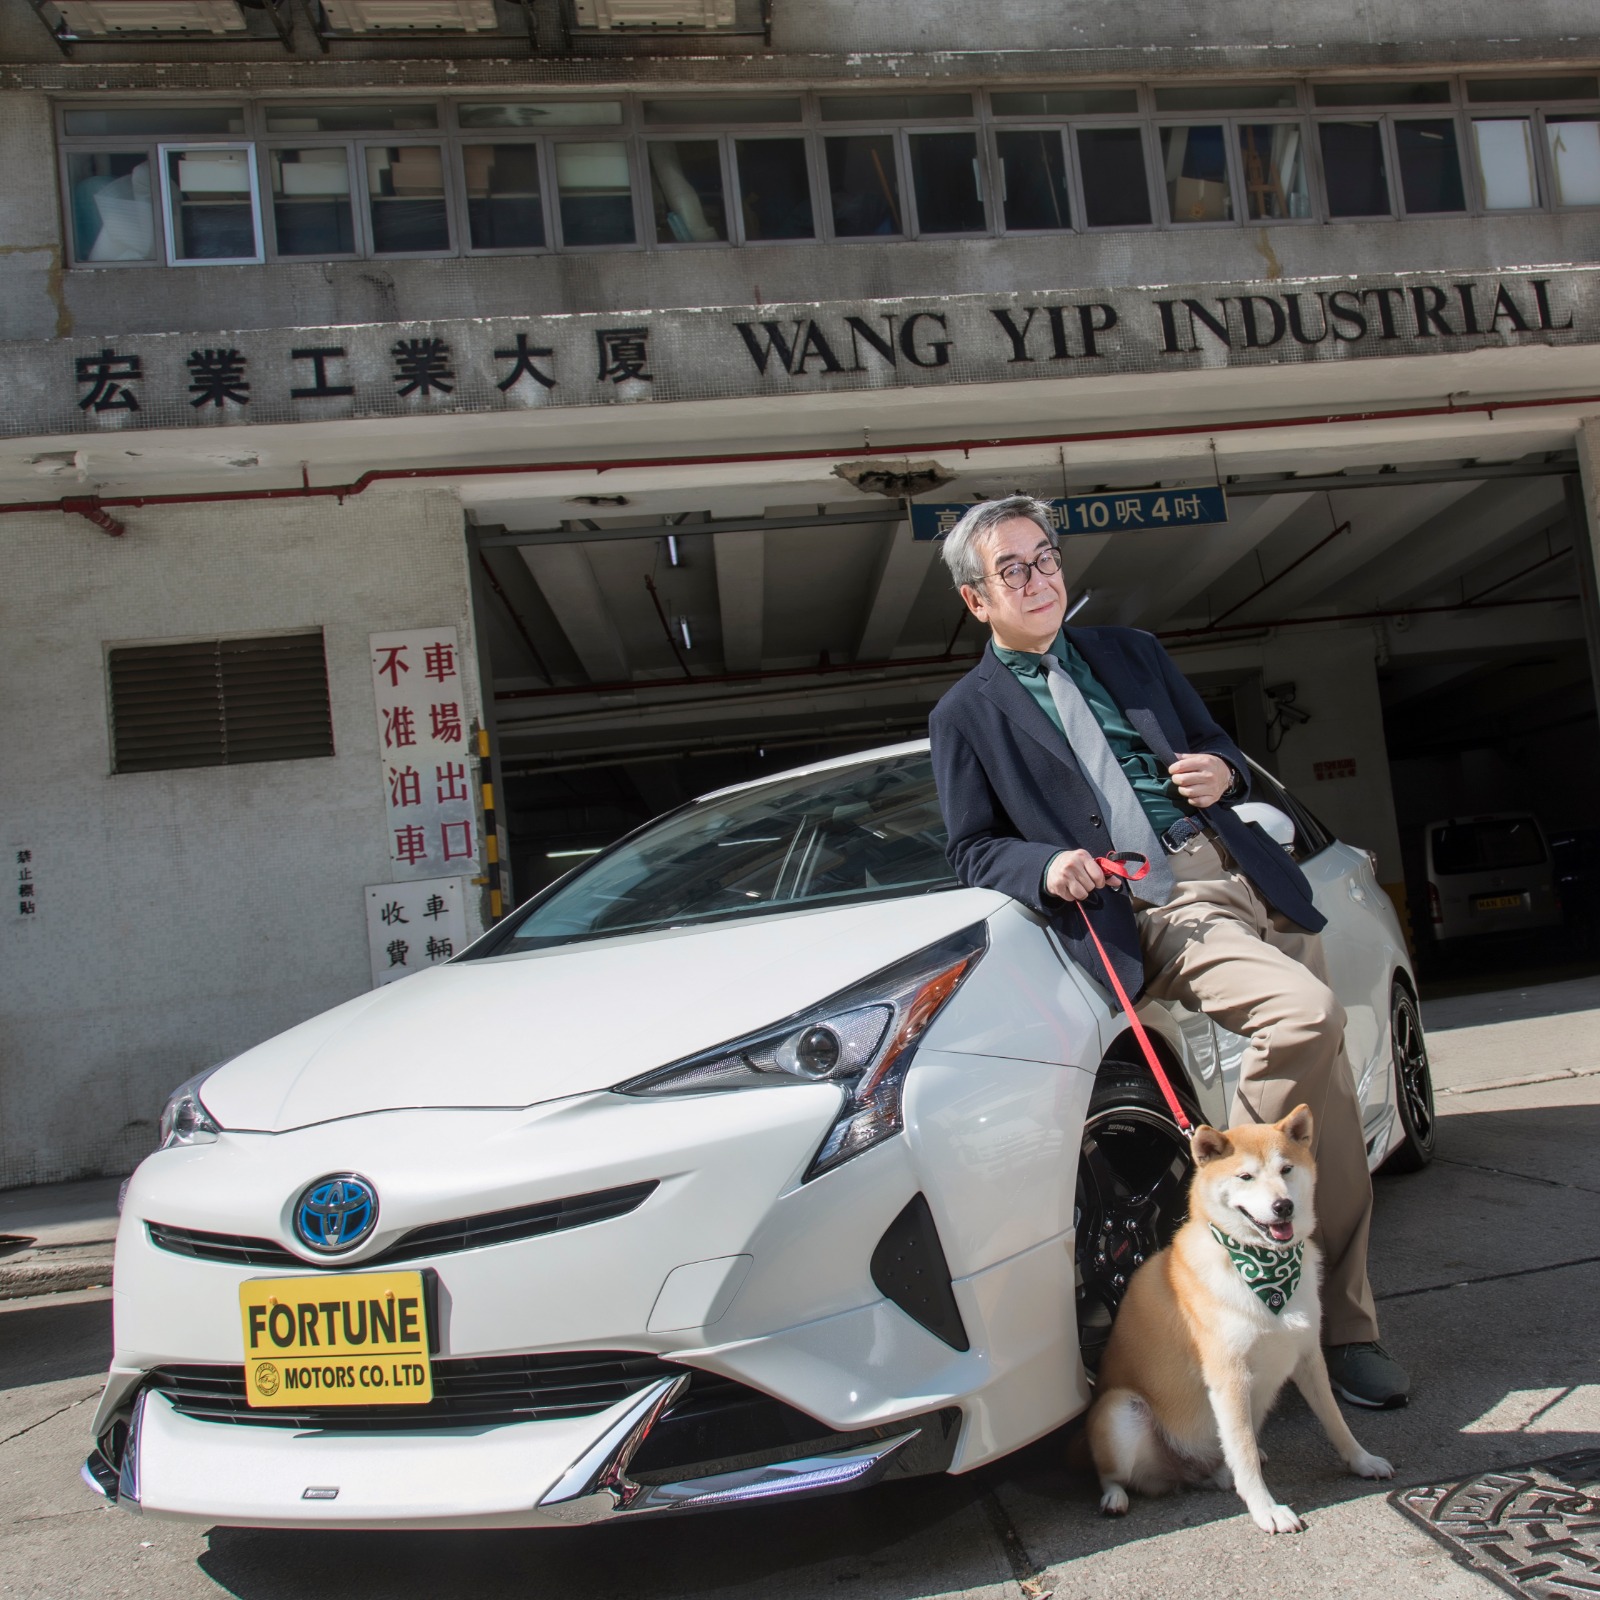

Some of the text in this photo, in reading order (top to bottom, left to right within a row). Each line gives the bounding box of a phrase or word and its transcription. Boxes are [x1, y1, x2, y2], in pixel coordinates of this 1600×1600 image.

[733, 279, 1575, 376] WANG YIP INDUSTRIAL
[375, 645, 428, 866] 不准泊車
[422, 642, 474, 862] 車場出口
[380, 901, 410, 968] 收費
[422, 894, 454, 962] 車輛
[248, 1297, 421, 1348] FORTUNE
[284, 1365, 356, 1390] MOTORS
[359, 1364, 389, 1388] CO.
[392, 1364, 425, 1387] LTD
